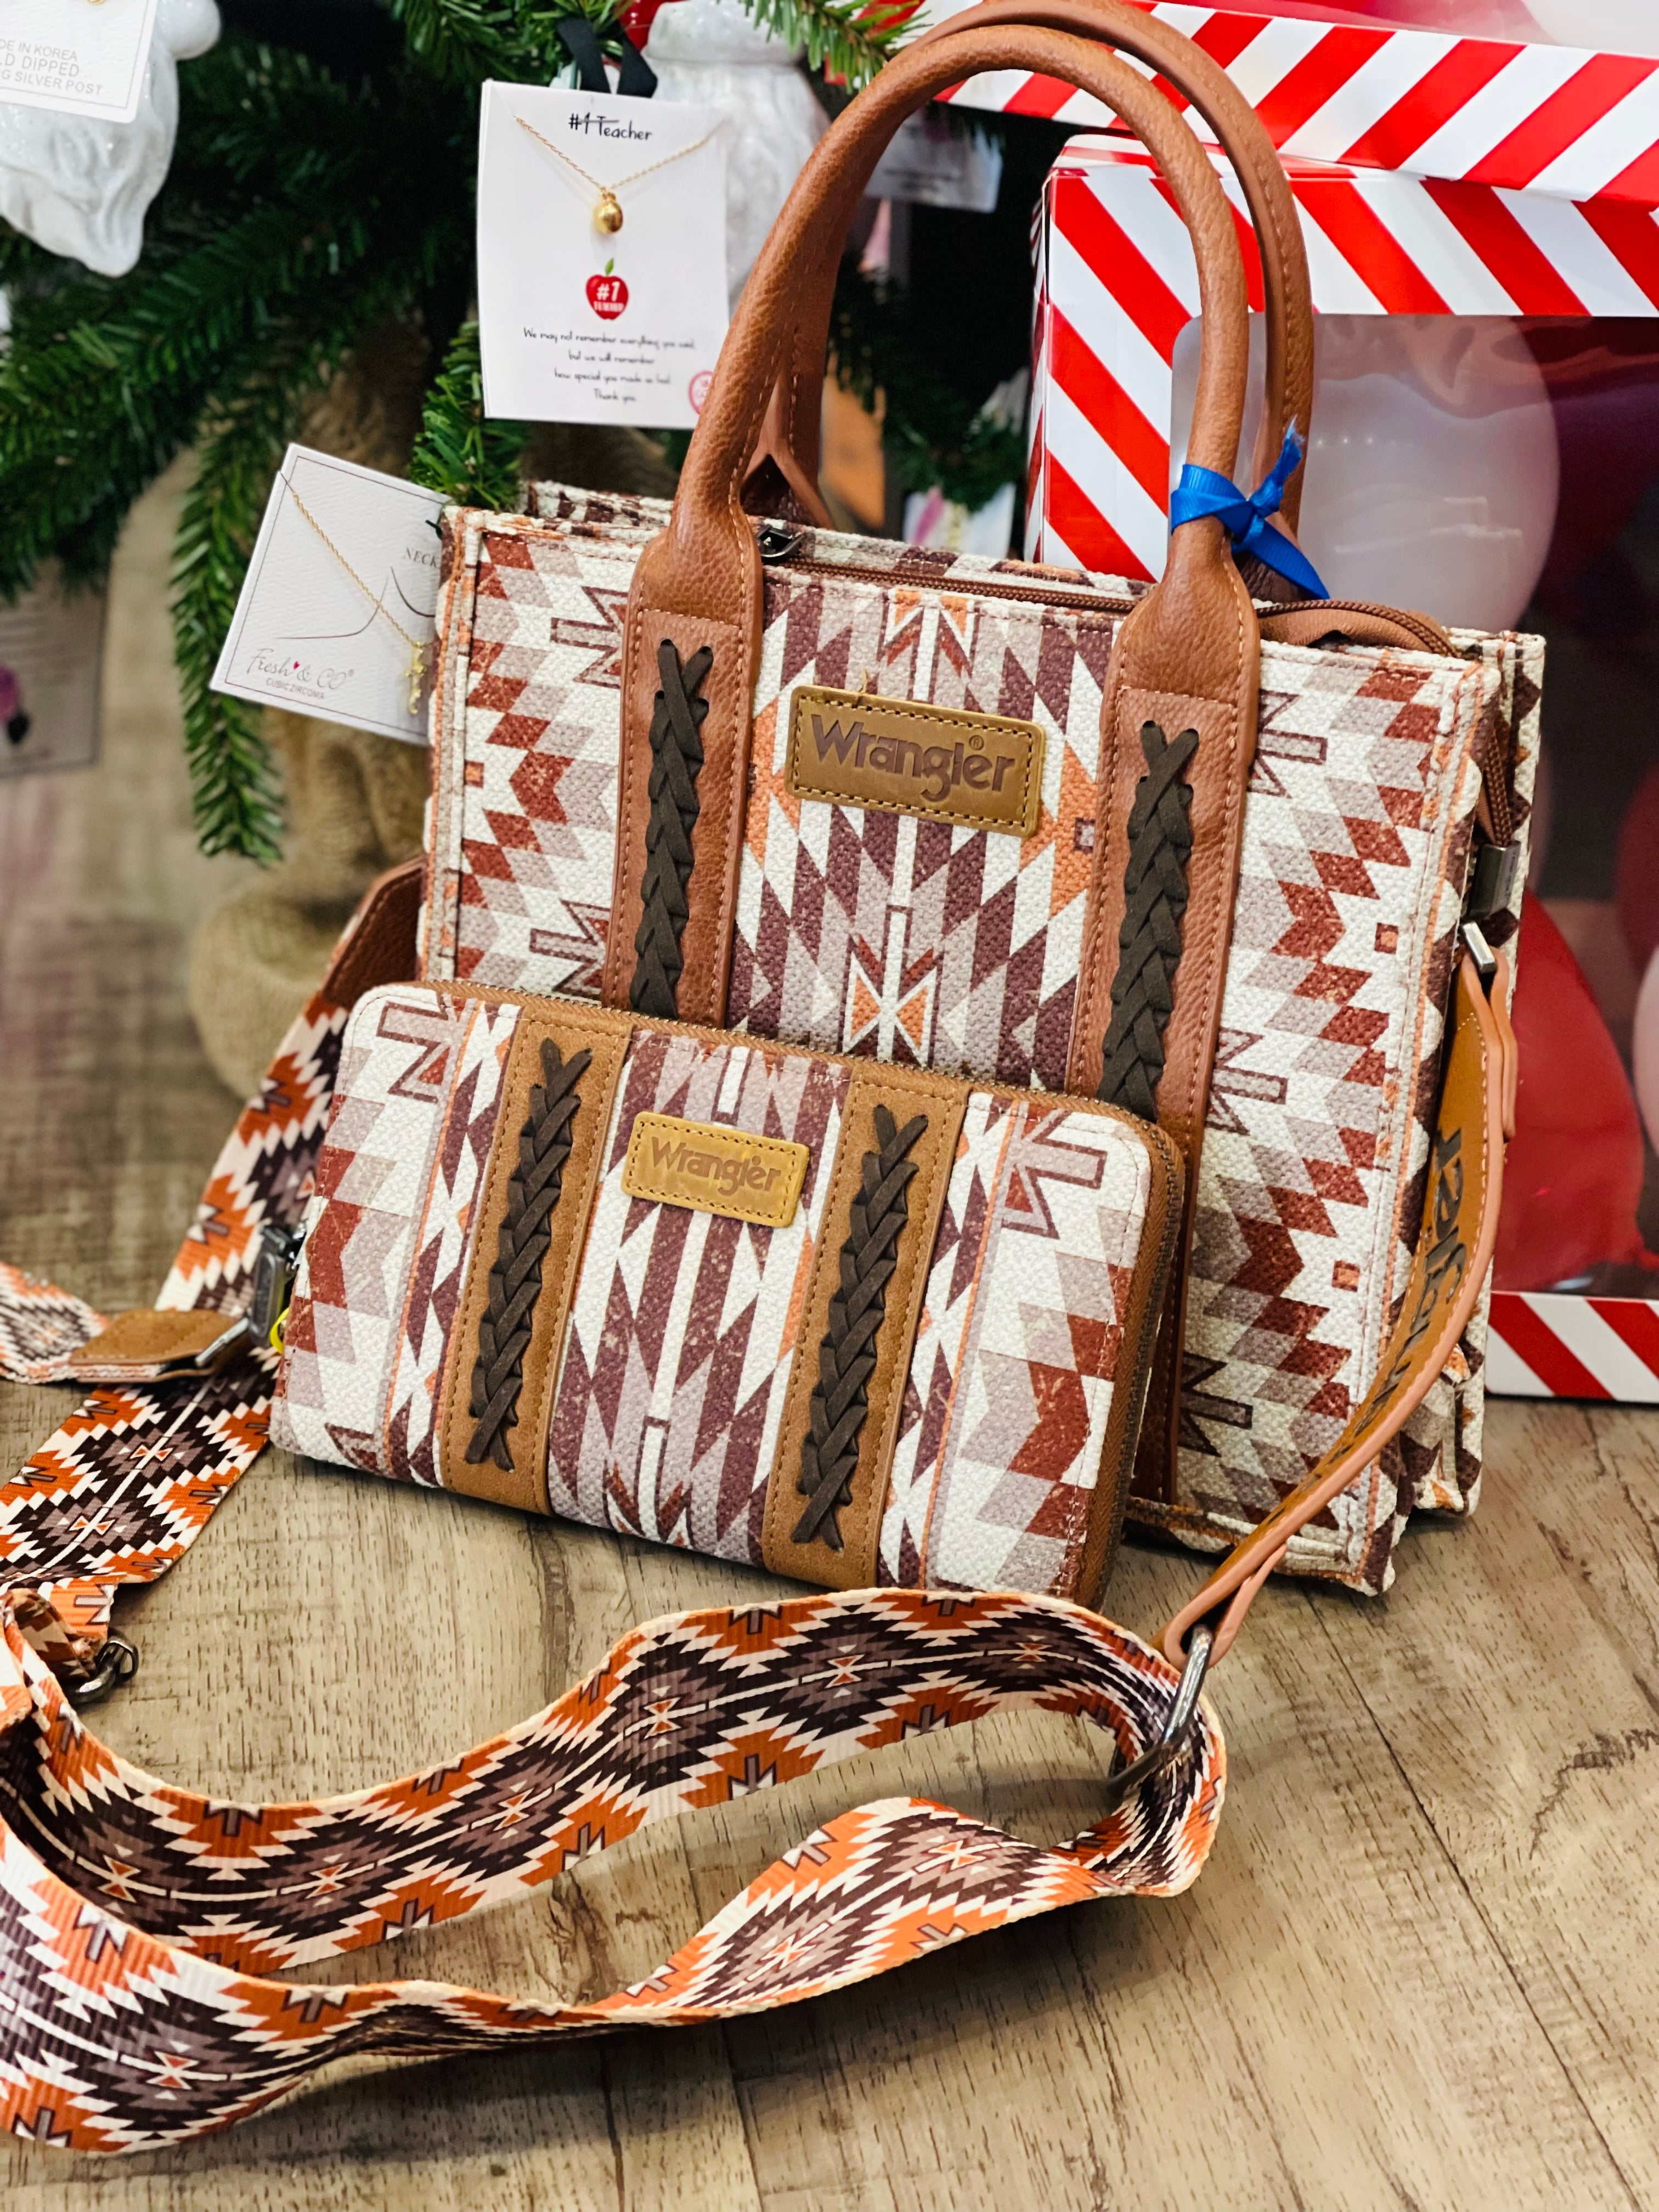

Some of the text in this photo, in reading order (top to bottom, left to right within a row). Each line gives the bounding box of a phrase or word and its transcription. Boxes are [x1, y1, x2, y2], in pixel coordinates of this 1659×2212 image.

[19, 42, 31, 53] IN
[34, 44, 77, 61] KOREA
[21, 55, 80, 77] DIPPED
[14, 71, 62, 89] SILVER
[65, 80, 103, 95] POST
[596, 116, 652, 140] Teacher
[596, 280, 620, 302] #1
[523, 326, 537, 338] We
[540, 333, 558, 344] may
[560, 330, 573, 341] not
[575, 331, 616, 343] remember
[568, 349, 581, 360] but
[554, 367, 571, 379] how
[574, 370, 601, 383] special
[593, 388, 619, 400] Thank
[247, 648, 293, 676] Fresh
[266, 678, 325, 699] CUBIC ZIRCONIA
[651, 1136, 782, 1196] Wrangler
